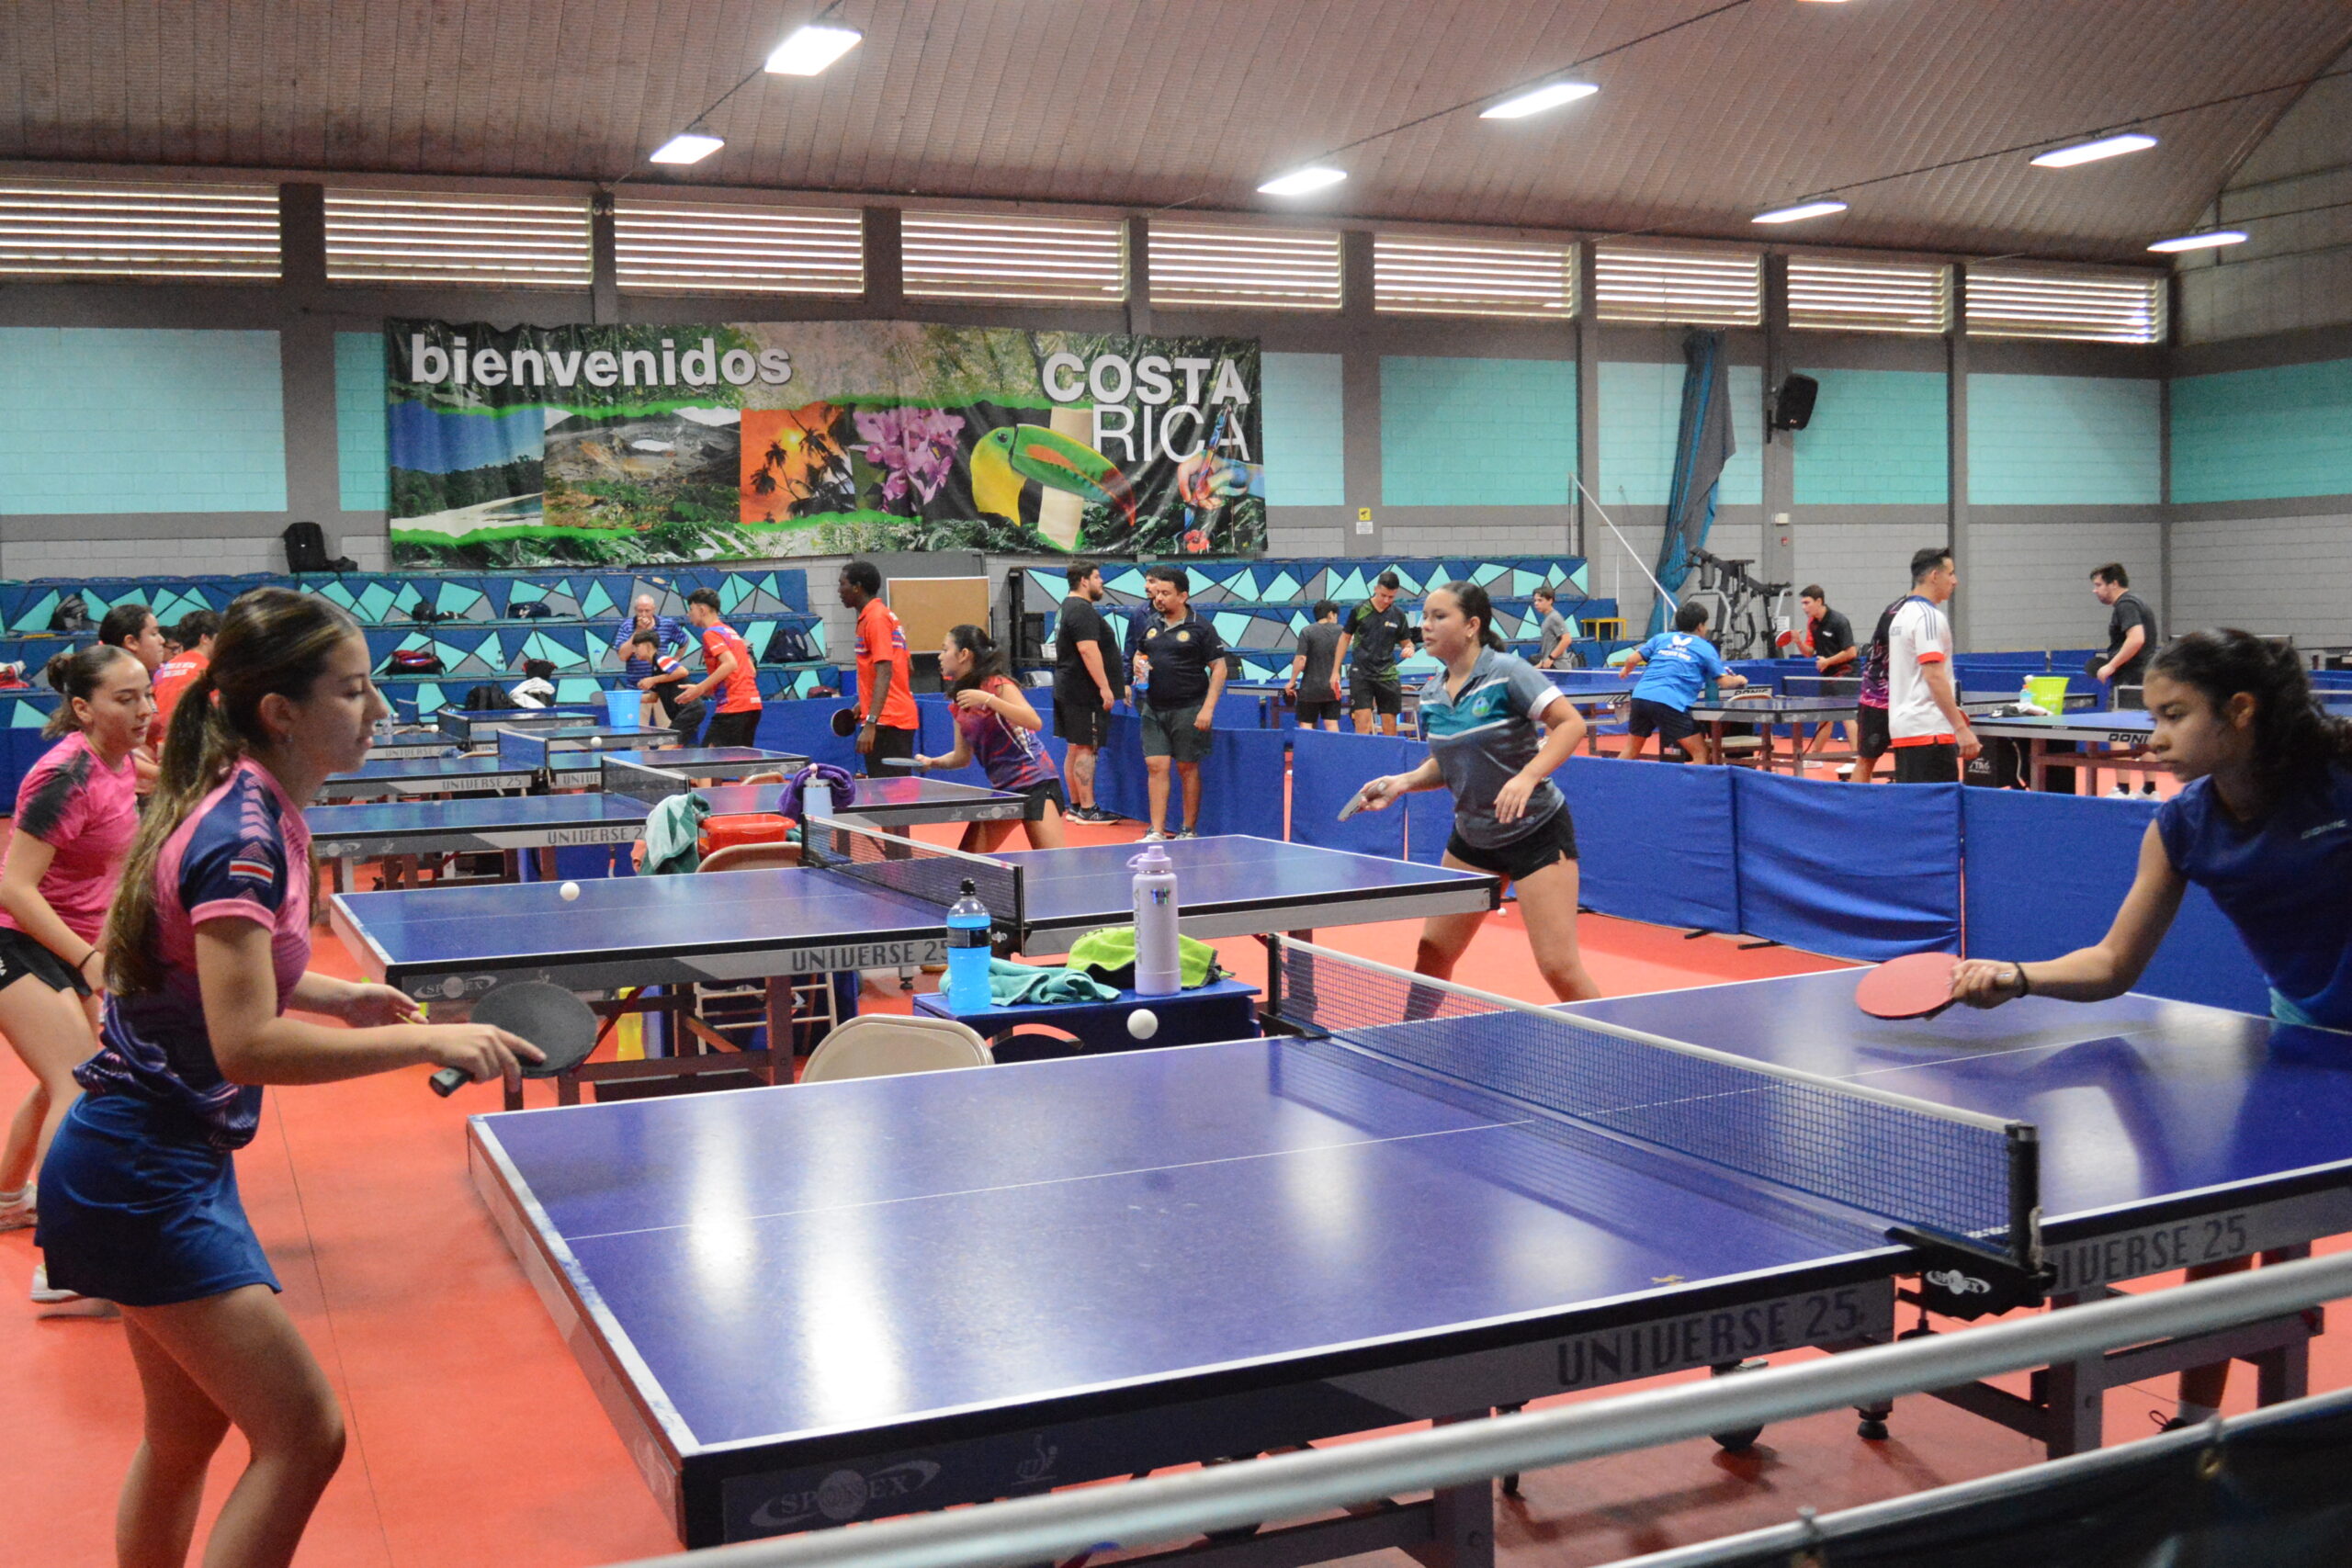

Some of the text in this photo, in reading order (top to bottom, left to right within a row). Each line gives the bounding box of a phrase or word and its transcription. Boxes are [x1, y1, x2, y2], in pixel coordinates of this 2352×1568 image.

[411, 333, 793, 387] bienvenidos
[1042, 352, 1250, 405] COSTA
[1092, 403, 1250, 463] RICA
[2108, 733, 2149, 745] DONI
[442, 777, 523, 791] UNIVERSE 25
[563, 773, 601, 786] UNIVE
[547, 827, 629, 845] UNIVERSE
[792, 942, 916, 973] UNIVERSE
[2058, 1213, 2248, 1289] IVERSE 25
[1556, 1288, 1861, 1386] UNIVERSE 25
